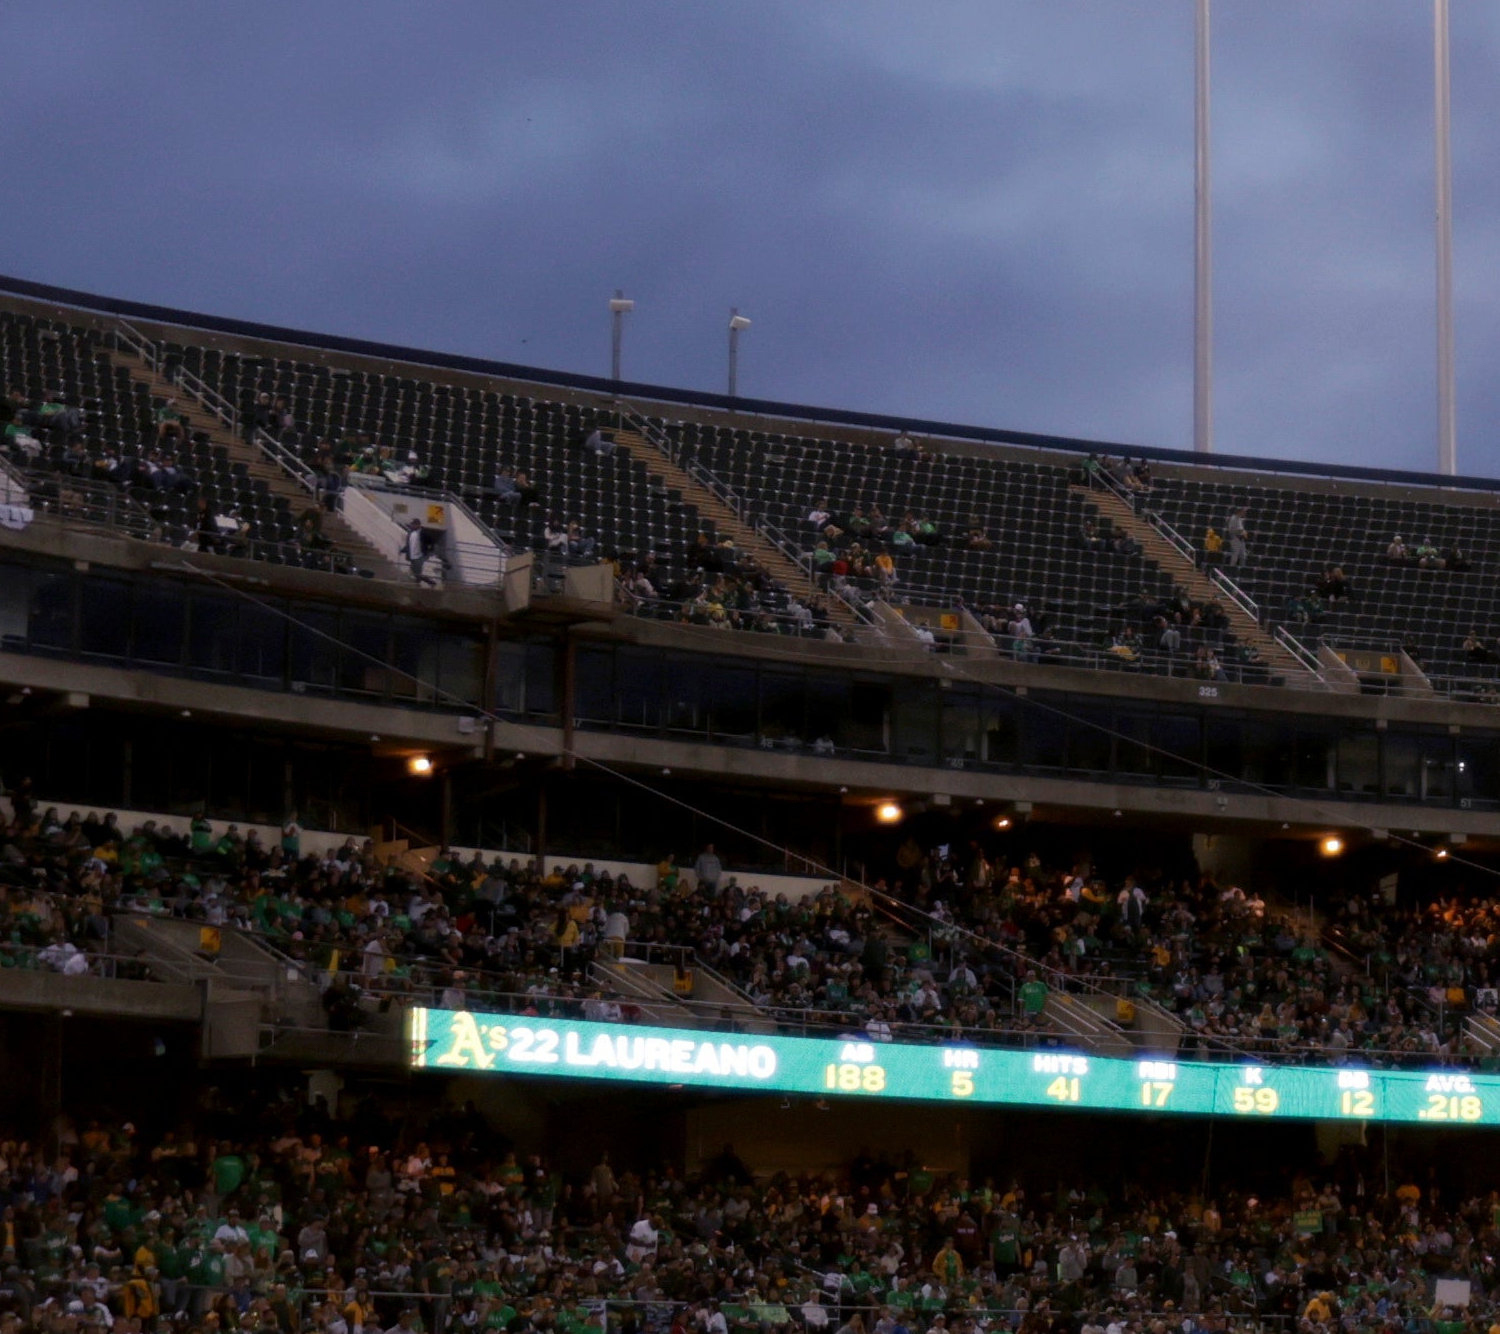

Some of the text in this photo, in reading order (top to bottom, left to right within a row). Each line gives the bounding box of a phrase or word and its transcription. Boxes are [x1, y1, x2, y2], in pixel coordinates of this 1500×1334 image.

[1200, 686, 1218, 697] 325
[508, 1027, 559, 1063] 22
[566, 1032, 778, 1079] LAUREANO
[841, 1044, 875, 1064] AB
[944, 1049, 979, 1069] HR
[1033, 1055, 1088, 1075] HITS
[1139, 1062, 1176, 1080] RBI
[1245, 1067, 1262, 1085] K
[1426, 1076, 1476, 1094] AVG.
[825, 1063, 1483, 1121] 188 5 41 17 59 12 .218
